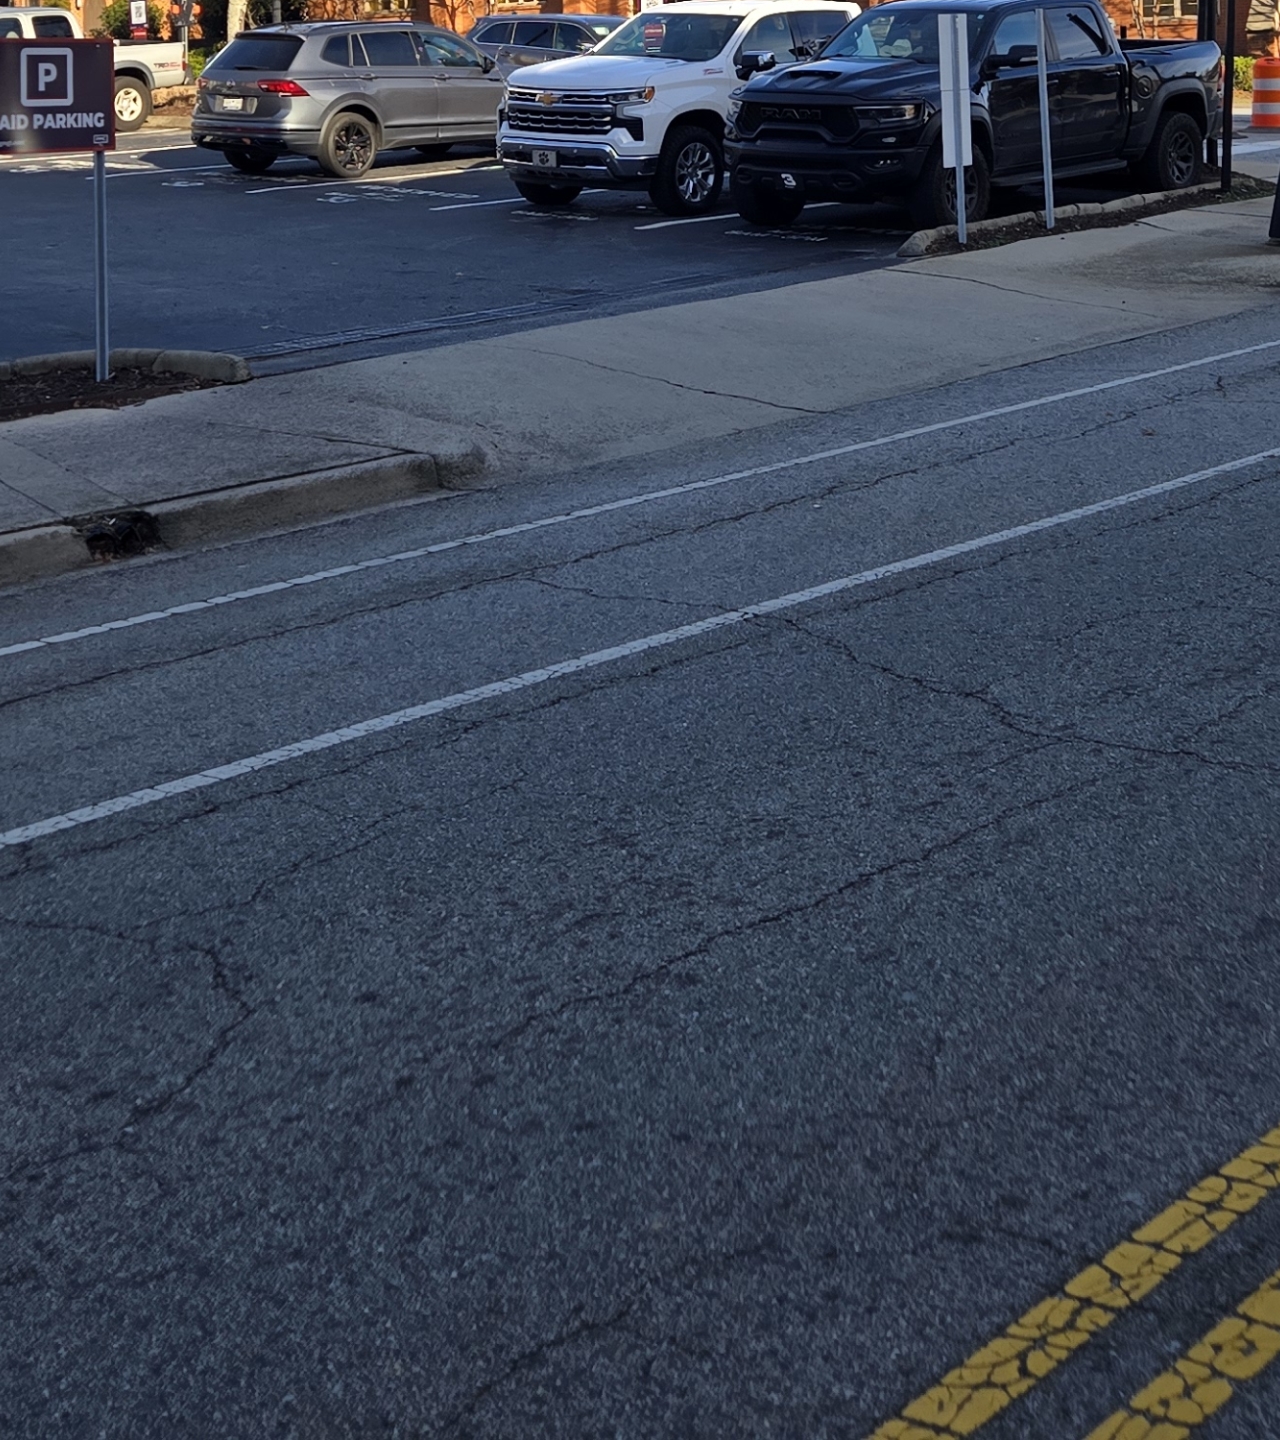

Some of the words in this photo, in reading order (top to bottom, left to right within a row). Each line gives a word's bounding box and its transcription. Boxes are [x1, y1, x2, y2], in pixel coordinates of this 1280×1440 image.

[38, 63, 57, 92] P
[32, 112, 105, 129] PARKING
[761, 107, 822, 119] RAM
[781, 173, 797, 186] 3
